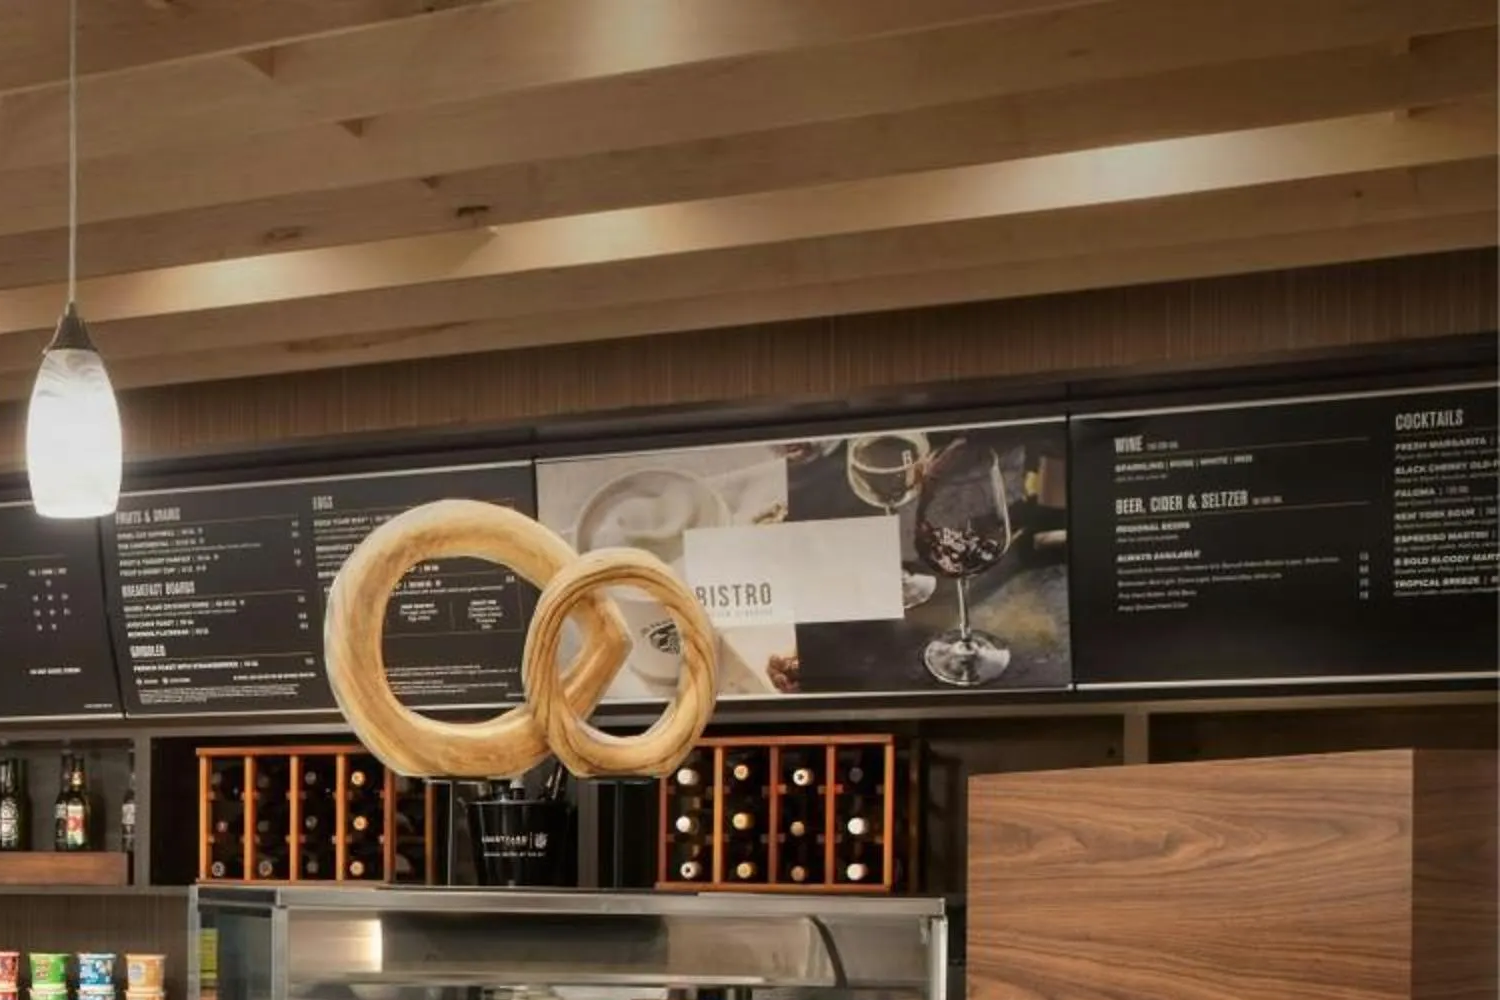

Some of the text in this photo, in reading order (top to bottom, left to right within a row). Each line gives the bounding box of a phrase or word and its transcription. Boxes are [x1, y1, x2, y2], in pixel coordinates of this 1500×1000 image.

[1394, 409, 1464, 431] COCKTAILS
[1113, 435, 1144, 453] WINE
[1115, 498, 1146, 516] BEER,
[1150, 495, 1184, 513] CIDER
[1187, 493, 1198, 510] &
[1201, 490, 1249, 510] SELTZER
[695, 582, 773, 608] BISTRO
